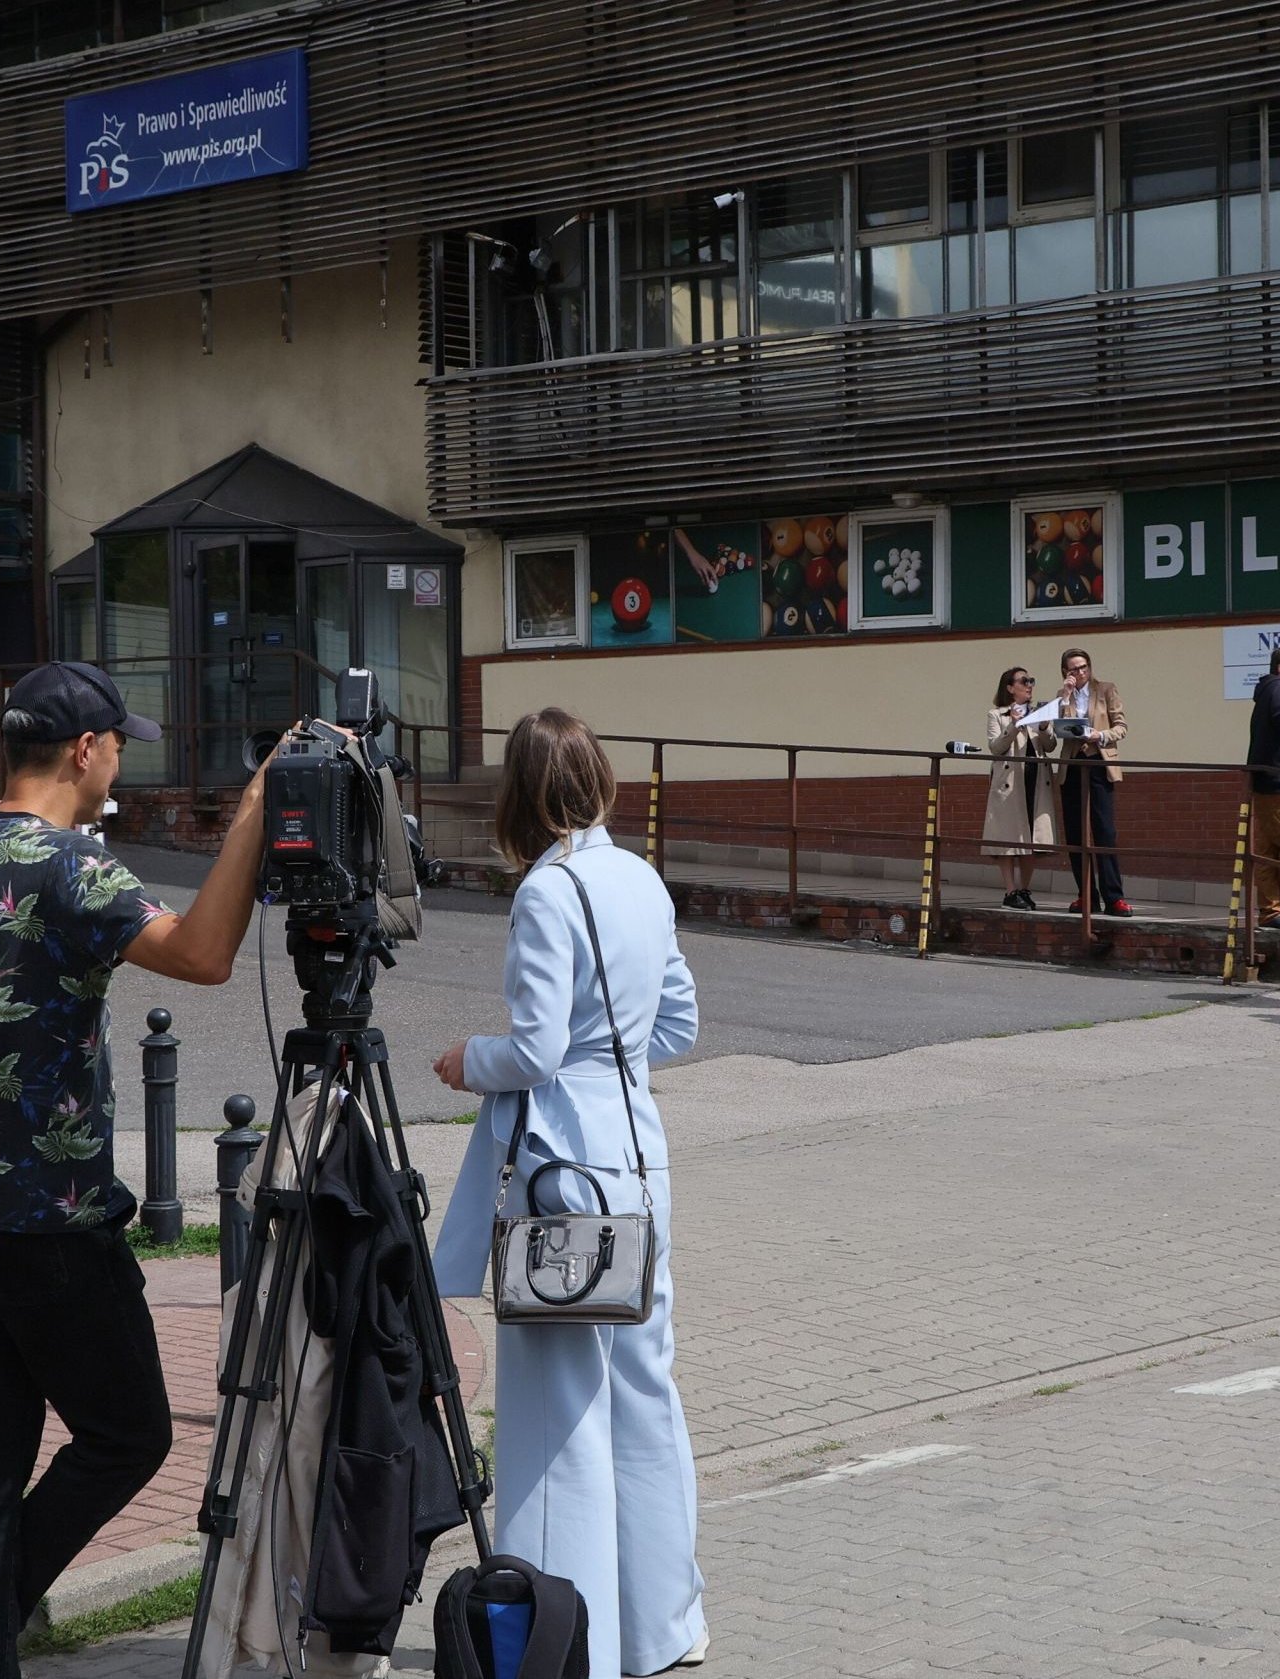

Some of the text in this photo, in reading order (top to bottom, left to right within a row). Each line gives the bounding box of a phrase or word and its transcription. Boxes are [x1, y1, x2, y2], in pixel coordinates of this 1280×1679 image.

[137, 80, 288, 136] Prawo i Sprawiedliwość
[163, 128, 262, 167] www.pis.org.pl
